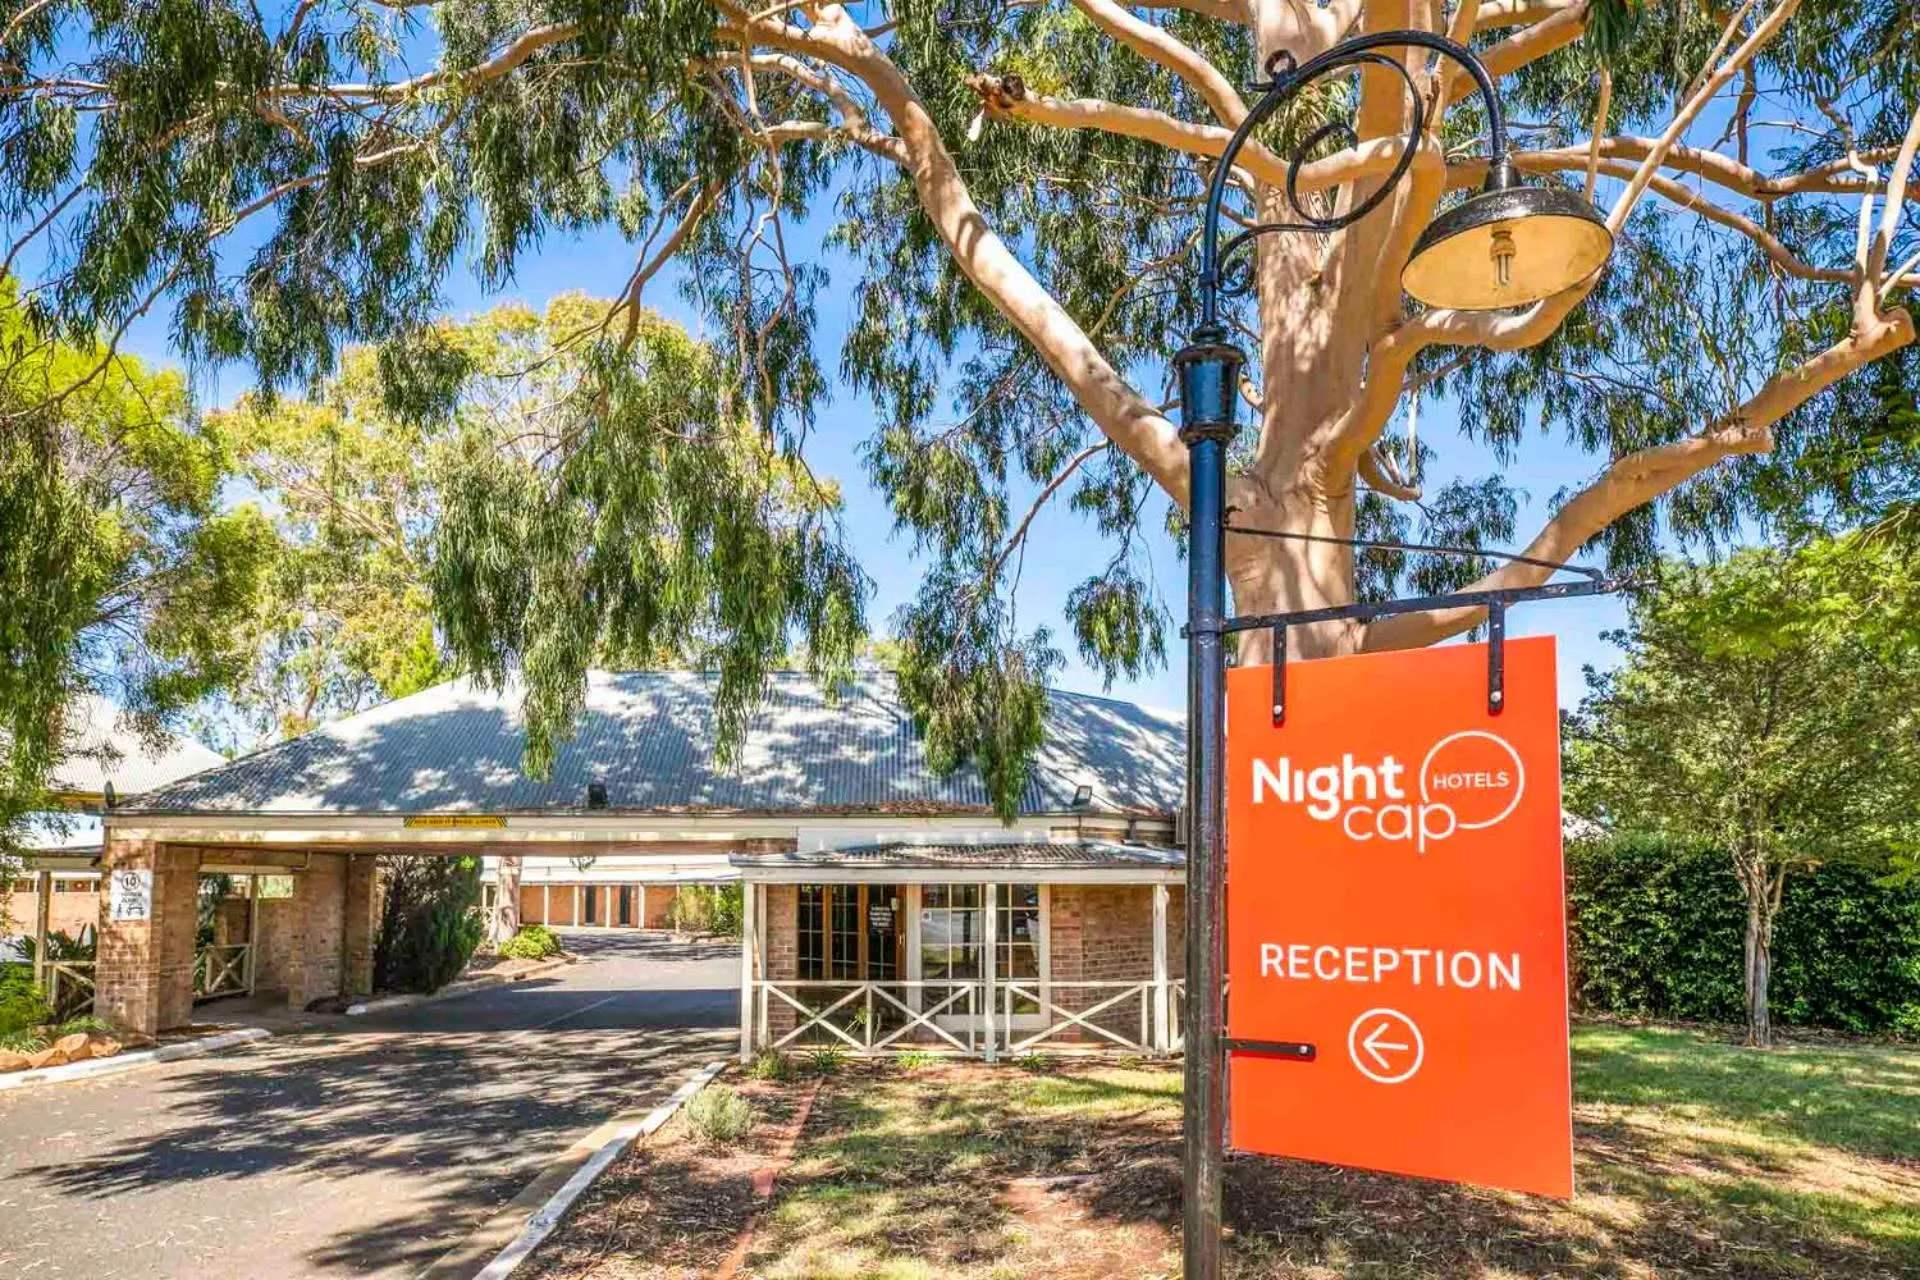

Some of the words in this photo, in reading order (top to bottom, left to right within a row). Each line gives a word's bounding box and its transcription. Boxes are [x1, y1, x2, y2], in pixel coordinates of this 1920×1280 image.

[1252, 754, 1405, 821] Night
[1433, 772, 1509, 788] HOTELS
[1343, 803, 1456, 853] cap
[124, 877, 136, 886] 10
[1260, 943, 1521, 990] RECEPTION
